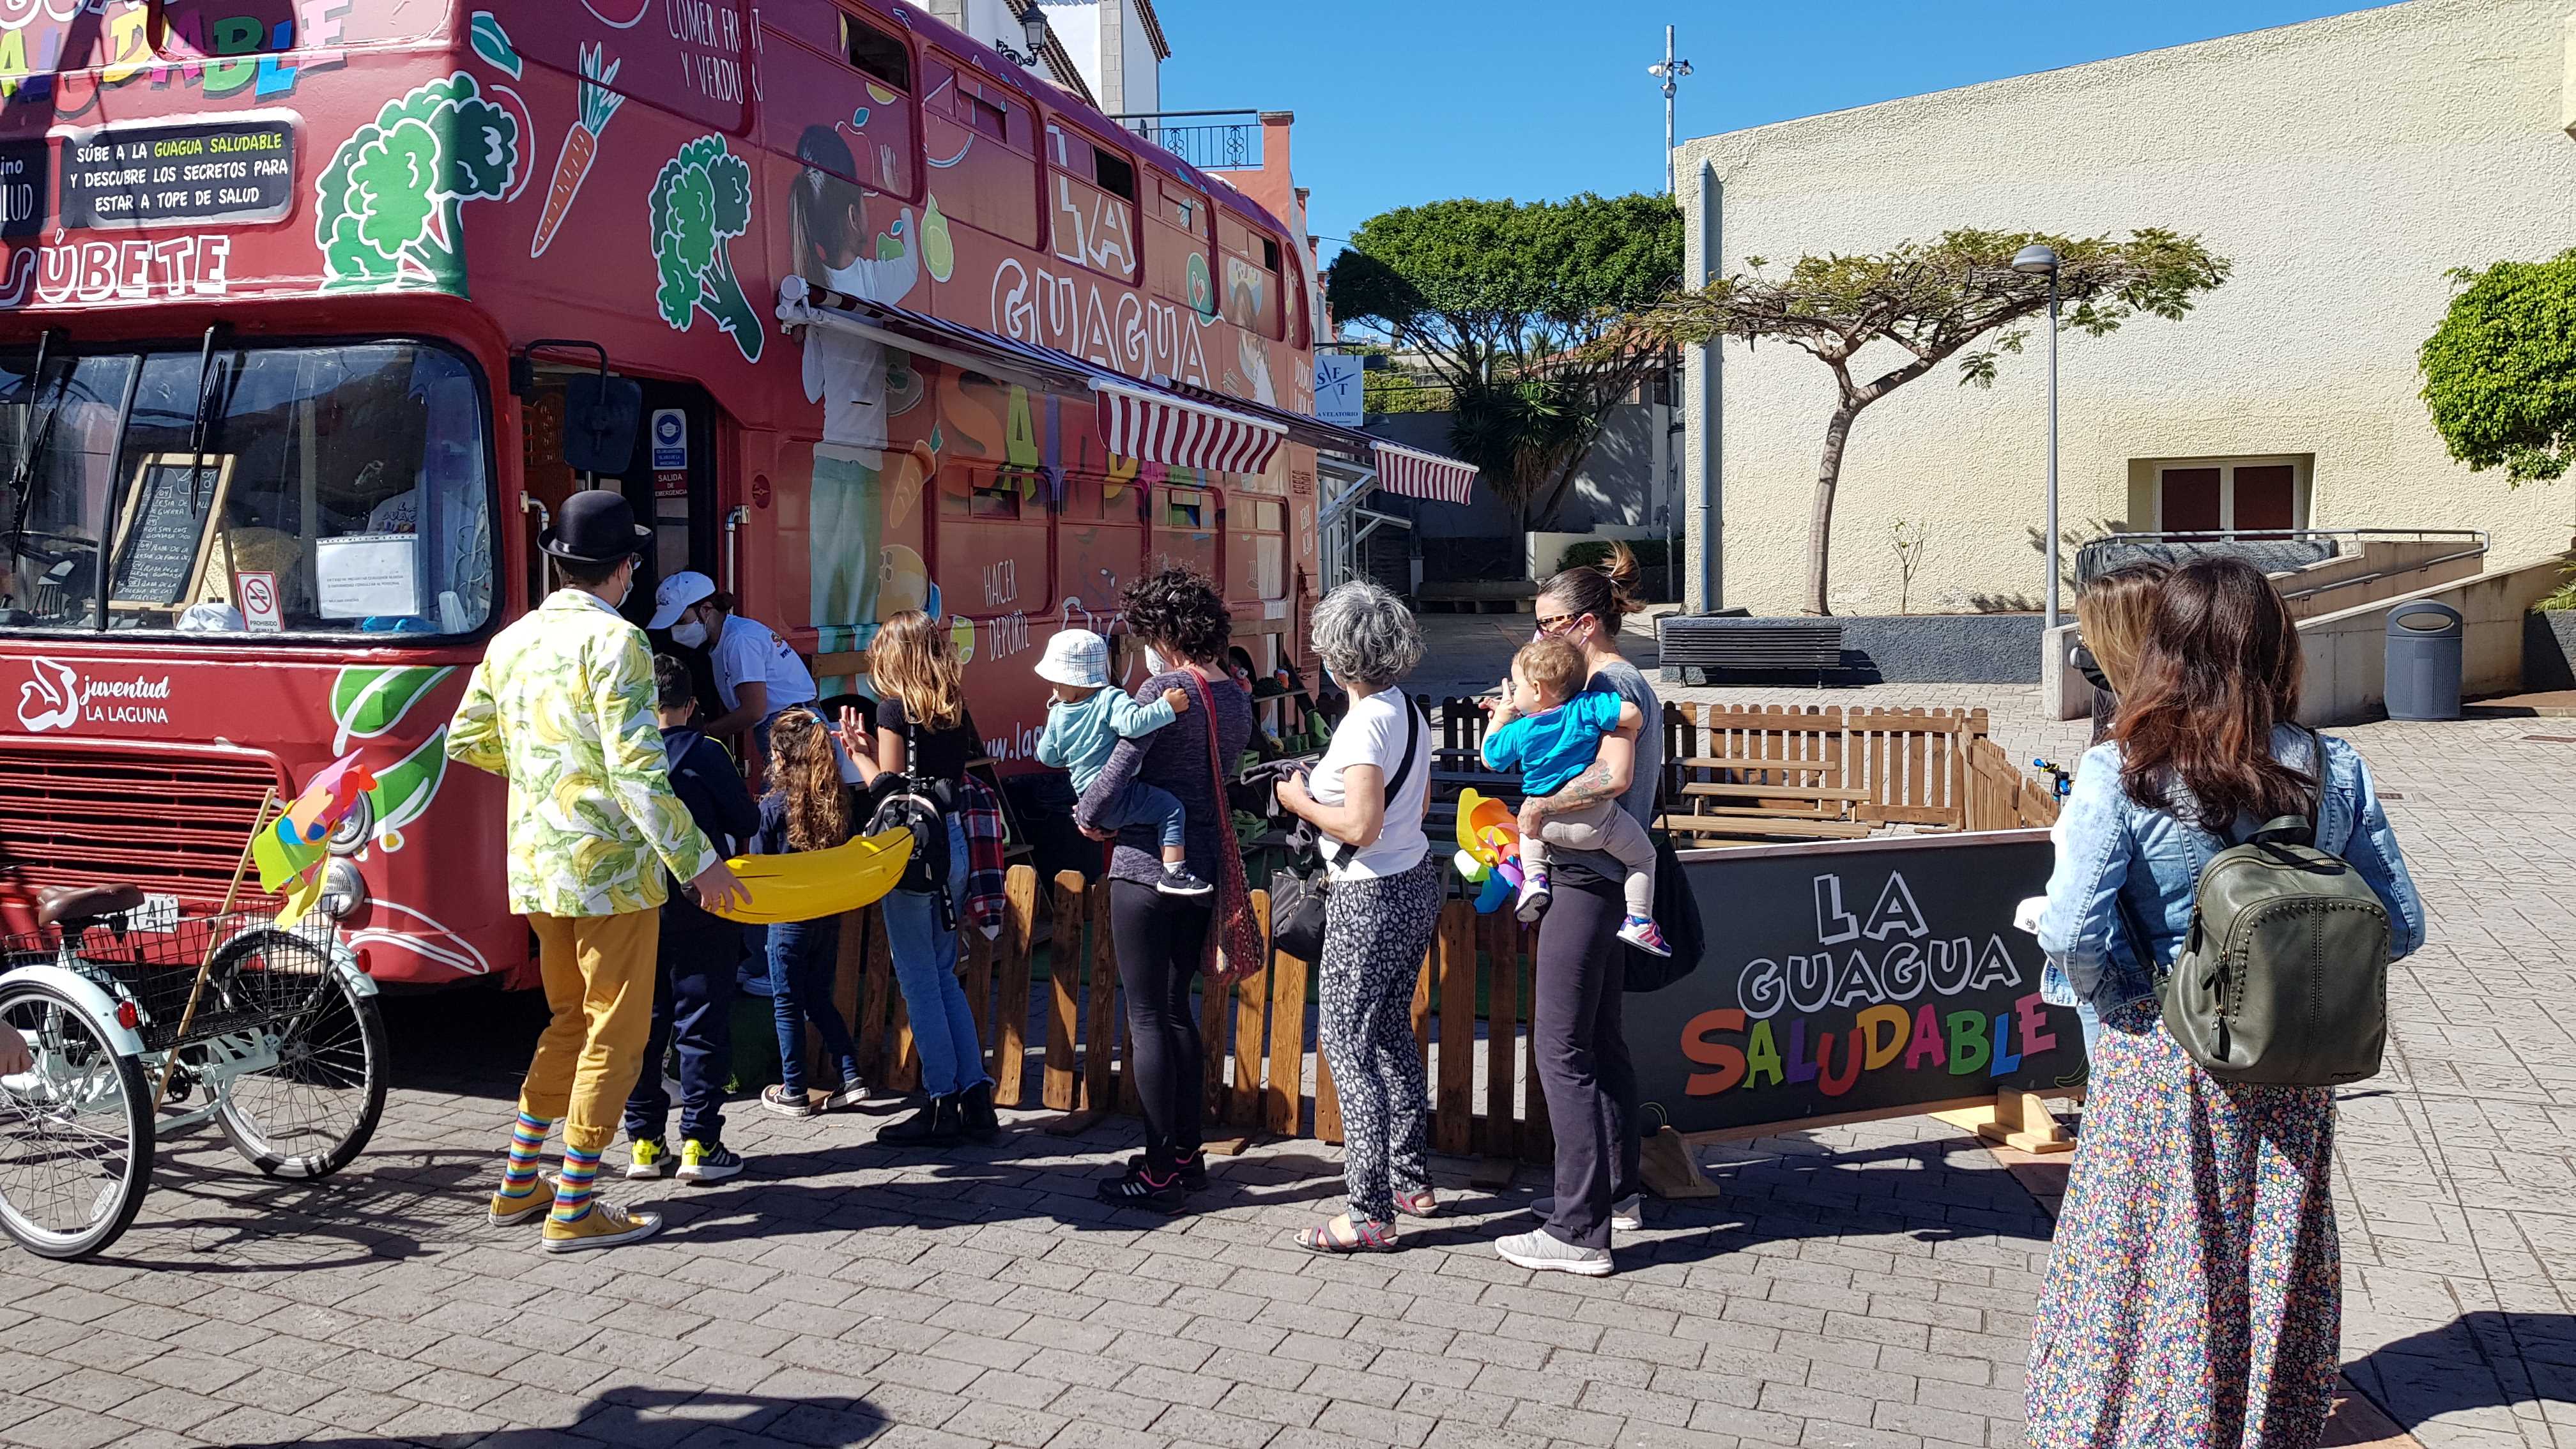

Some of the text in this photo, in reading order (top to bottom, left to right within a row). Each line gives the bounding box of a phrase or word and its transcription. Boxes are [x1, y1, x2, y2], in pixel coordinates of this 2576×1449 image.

[680, 50, 691, 88] Y
[116, 144, 125, 161] A
[132, 144, 148, 160] LA
[153, 138, 203, 158] GUAGUA
[209, 132, 282, 154] SALUDABLE
[70, 158, 289, 189] Y DESCUBRE LOS SECRETOS PARA
[95, 186, 259, 213] ESTAR A TOPE DE SALUD
[1046, 125, 1137, 275] LA
[991, 257, 1211, 390] GUAGUA
[658, 473, 682, 482] SALIDA
[983, 558, 1018, 608] HACER
[988, 610, 1031, 662] DEPORTE
[79, 675, 171, 706] juventud
[86, 705, 169, 723] LA LAGUNA
[1813, 869, 1929, 946] LA
[1736, 933, 2021, 1020] GUAGUA
[1680, 992, 2057, 1097] SALUDABLE
